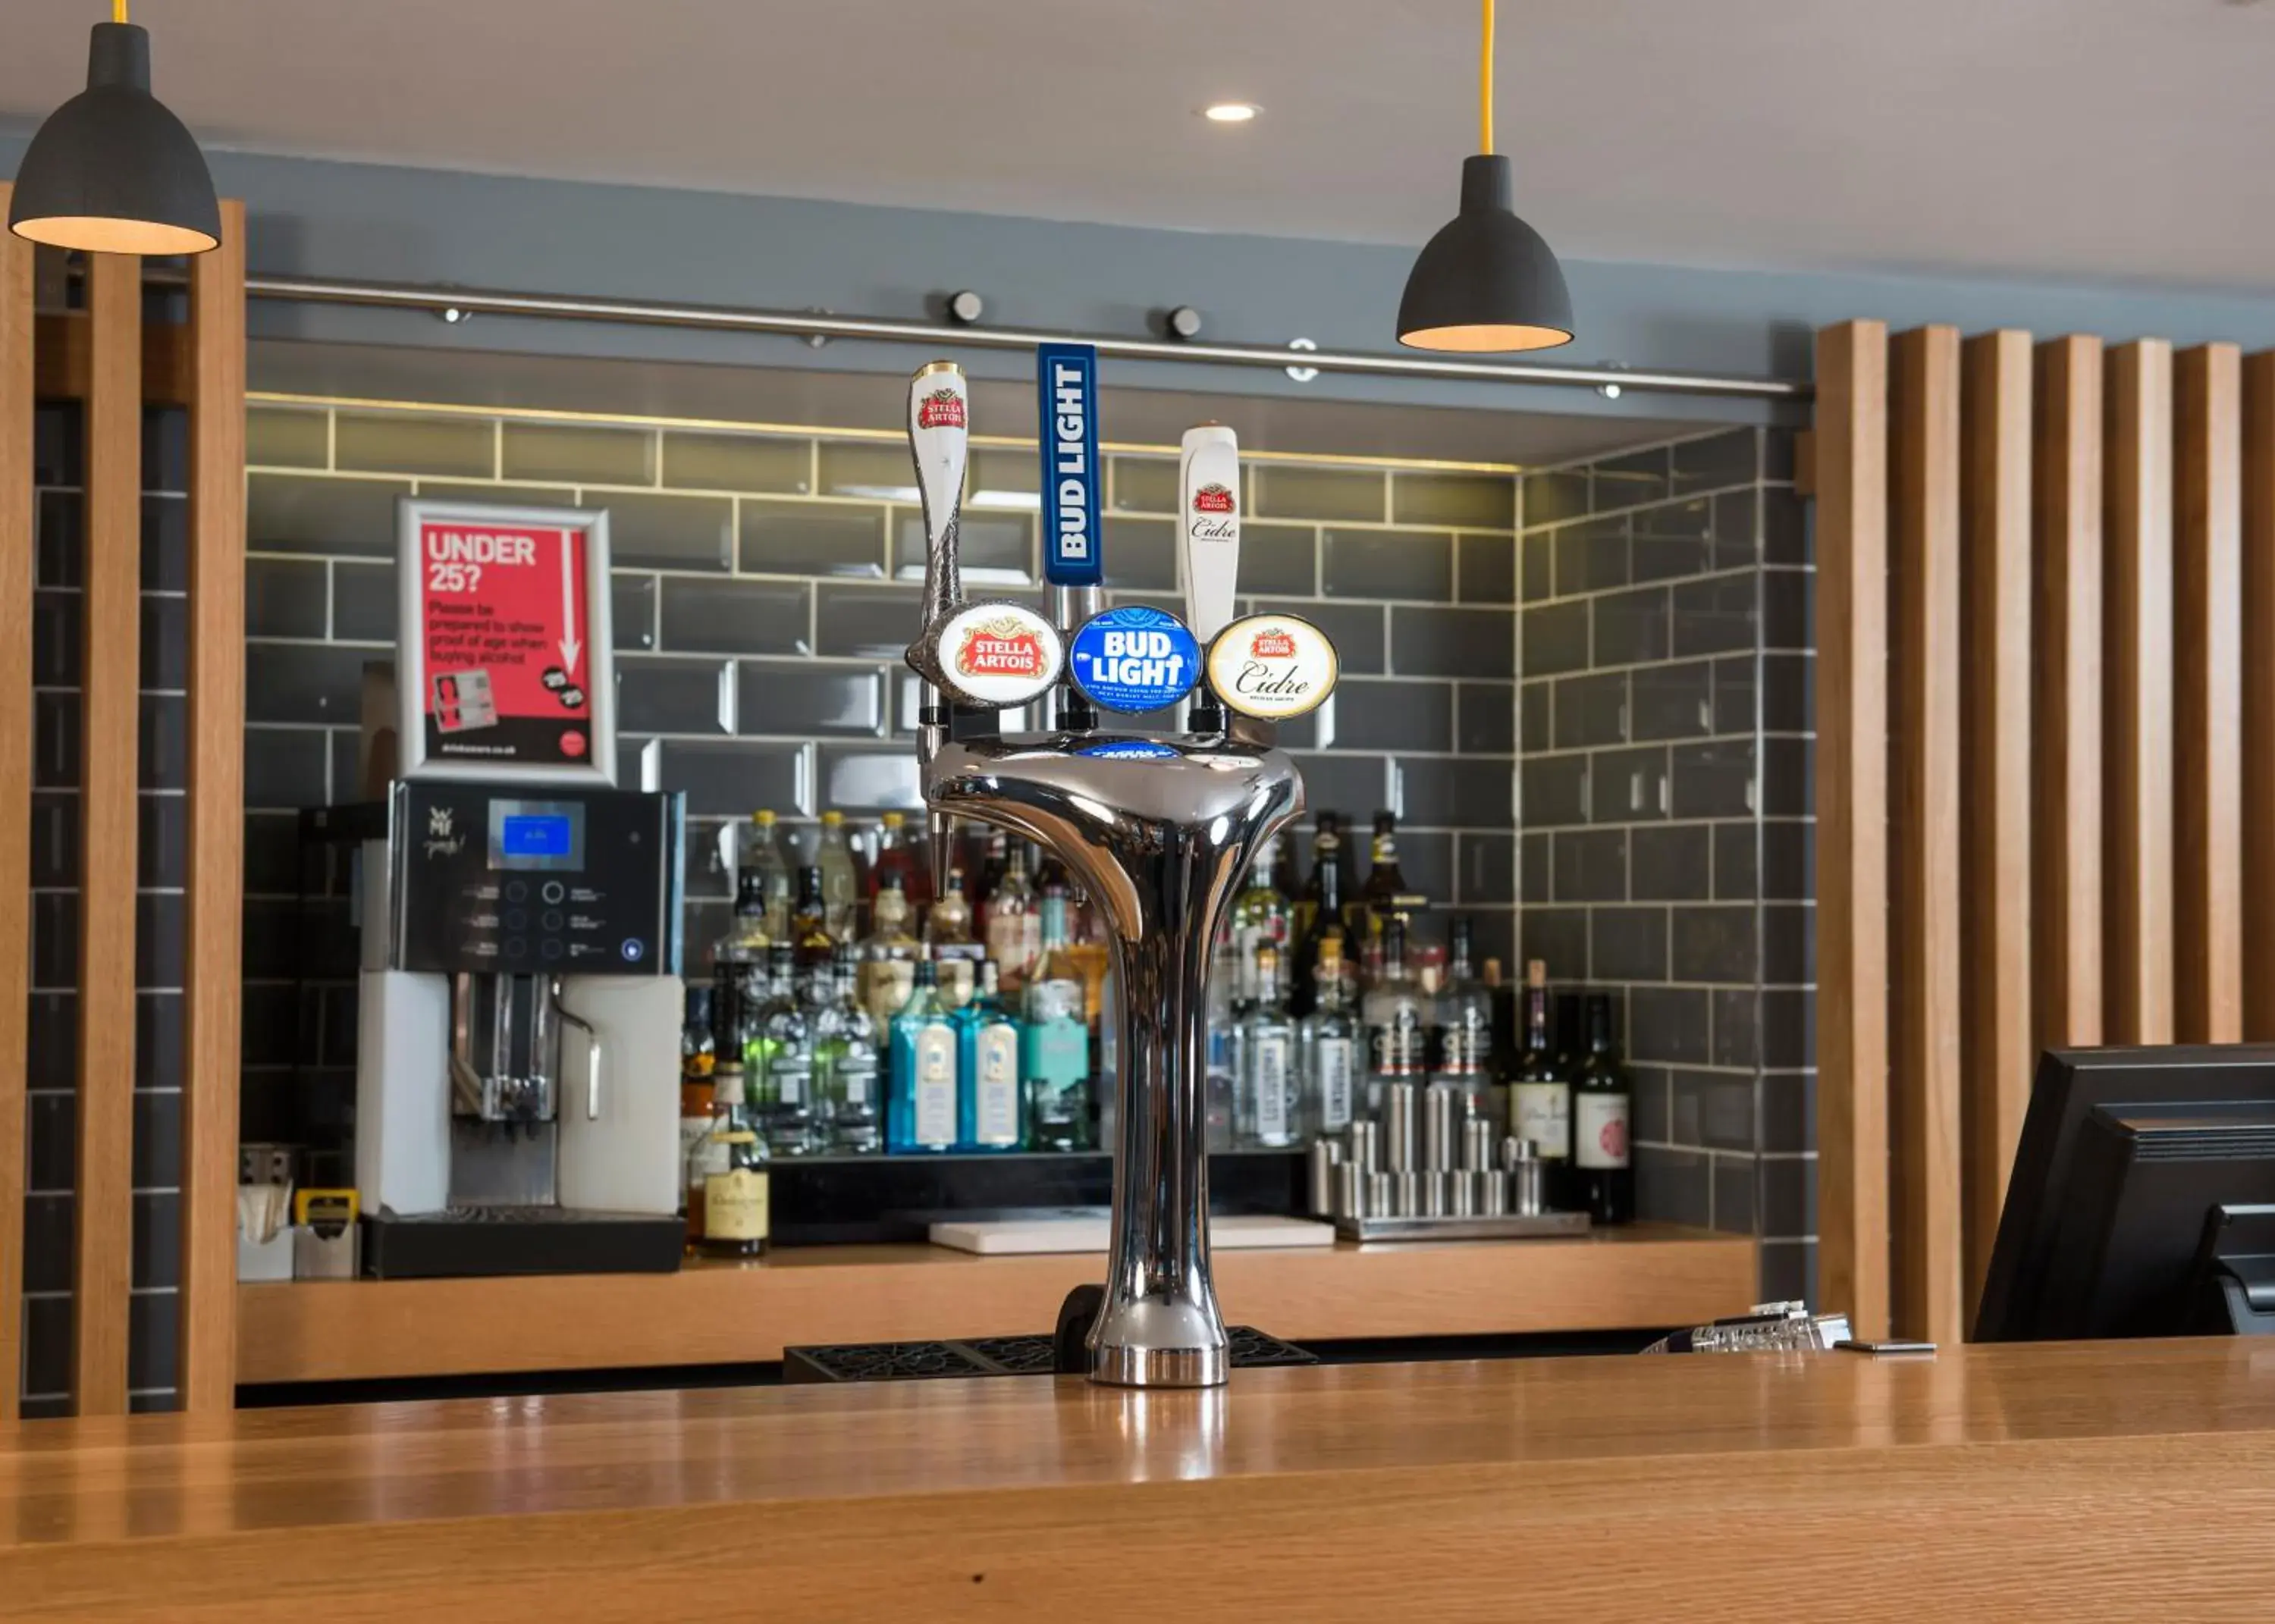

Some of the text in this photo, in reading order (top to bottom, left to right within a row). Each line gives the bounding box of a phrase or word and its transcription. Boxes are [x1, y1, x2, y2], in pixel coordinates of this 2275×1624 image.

[927, 403, 961, 413] STELLA
[927, 413, 962, 422] ARTOIS
[1055, 364, 1087, 558] BUD LIGHT
[1200, 494, 1226, 503] STELLA
[1191, 516, 1235, 538] Cidre
[428, 531, 537, 566] UNDER
[428, 562, 482, 593] 25?
[975, 640, 1034, 656] STELLA
[1103, 631, 1172, 658] BUD
[1258, 645, 1289, 654] ARTOIS
[973, 654, 1034, 669] ARTOIS
[1092, 656, 1184, 686] LIGHT
[1235, 660, 1310, 694] Cidre
